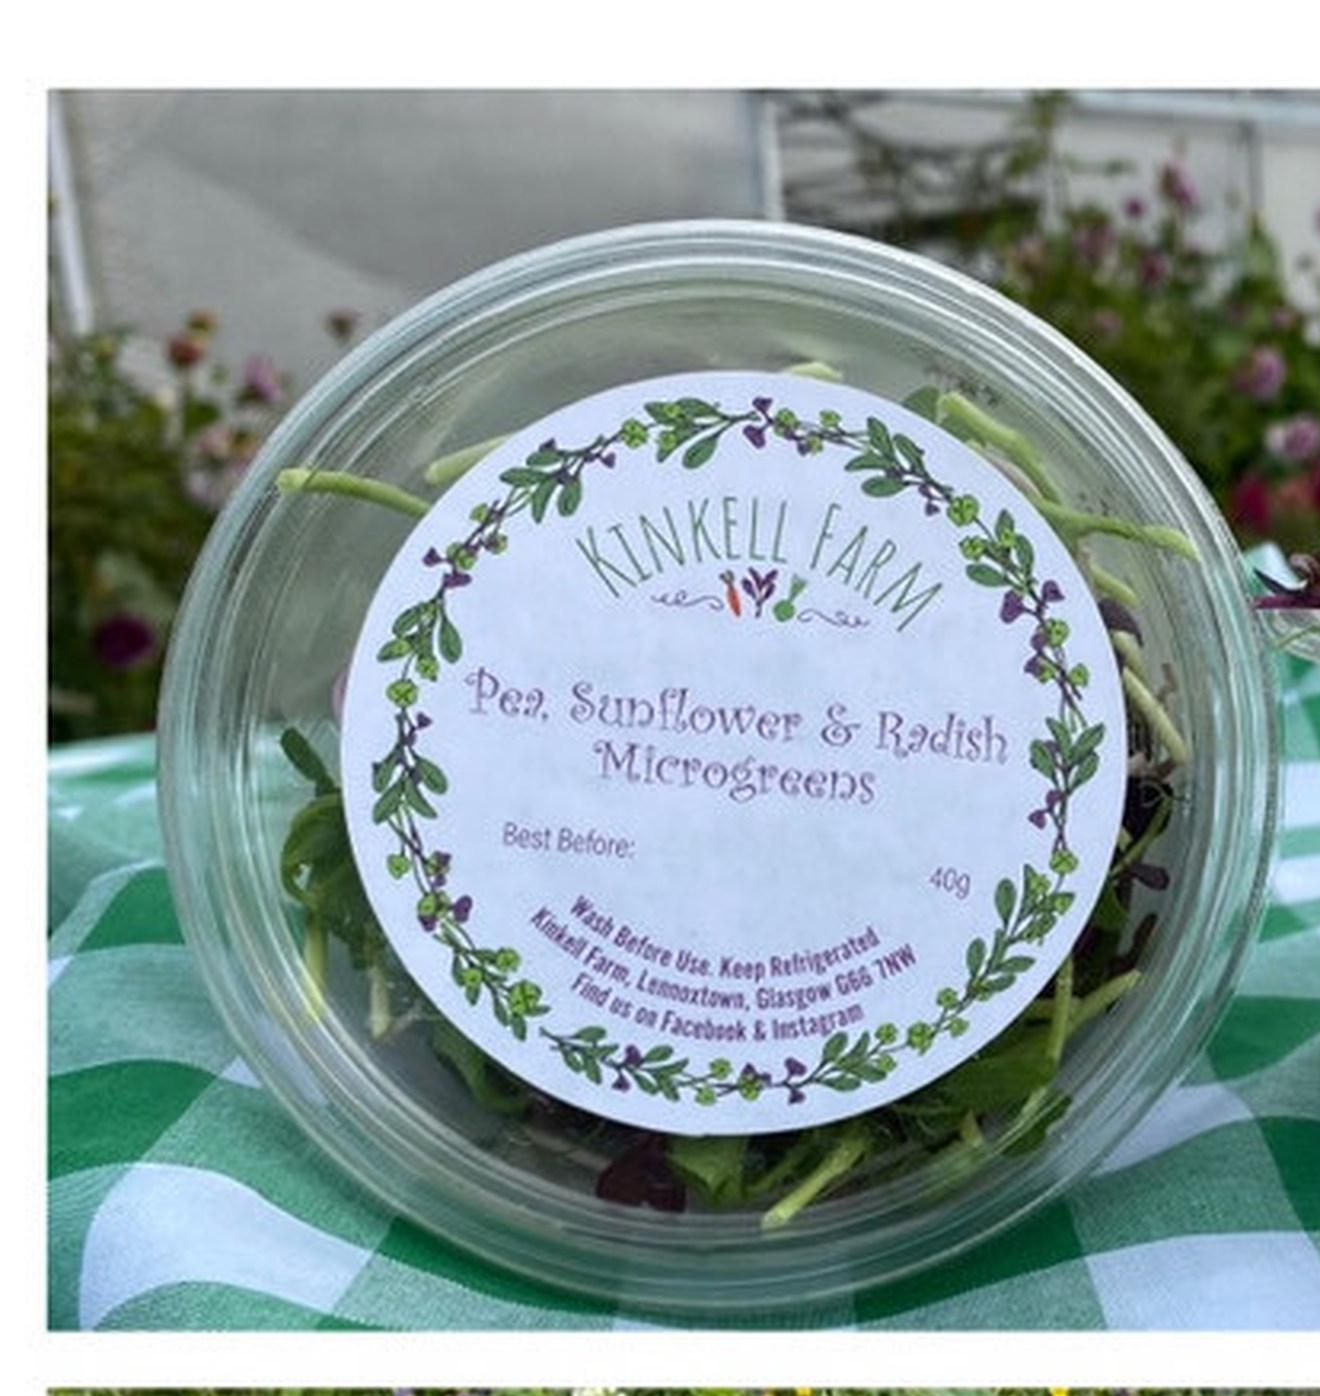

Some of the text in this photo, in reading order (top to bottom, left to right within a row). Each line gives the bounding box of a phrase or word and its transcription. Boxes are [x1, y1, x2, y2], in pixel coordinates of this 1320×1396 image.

[576, 497, 942, 632] KINKELL FARM
[569, 680, 802, 743] Sunflower
[821, 702, 861, 747] &
[876, 710, 1008, 765] Radish
[593, 739, 876, 804] Microgreens
[502, 822, 636, 859] Best Before:
[929, 866, 971, 900] 40g
[531, 907, 917, 1012] Kinkell Farm, Lennoxtown, Glasgow G66 7NW
[570, 894, 881, 983] Wash Before Use. Keep Refrigerated
[571, 972, 865, 1042] Find us on Facebook & Instagram
